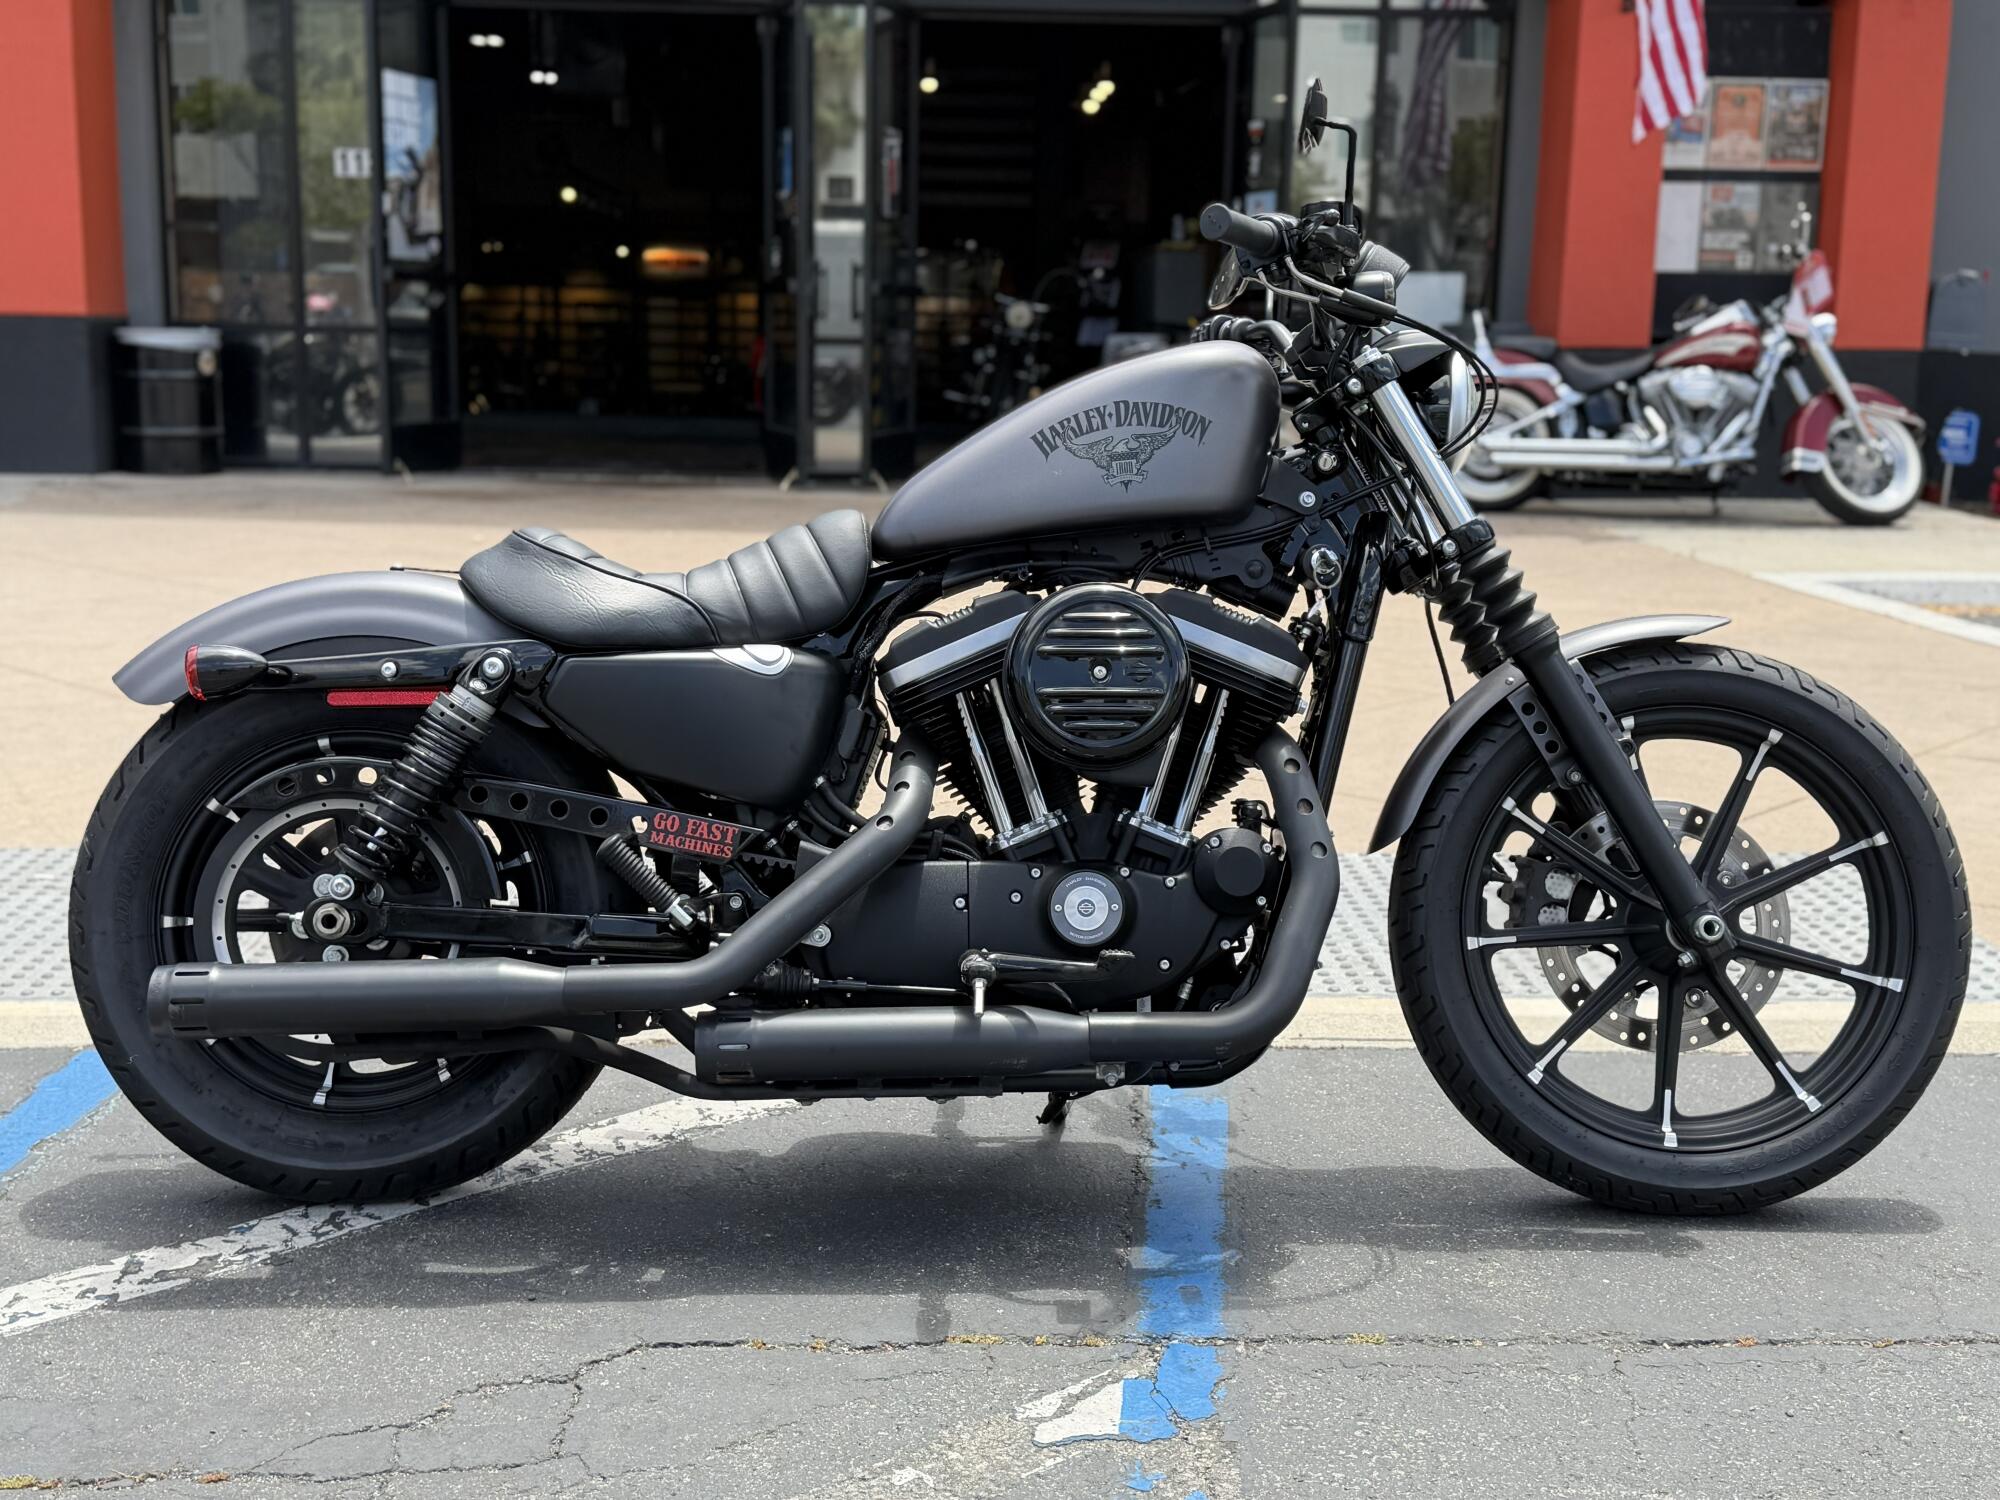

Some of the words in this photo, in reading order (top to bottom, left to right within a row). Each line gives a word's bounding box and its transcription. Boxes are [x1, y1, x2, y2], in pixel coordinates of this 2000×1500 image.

[653, 812, 680, 832] GO
[685, 818, 740, 844] FAST
[649, 831, 733, 858] MACHINES
